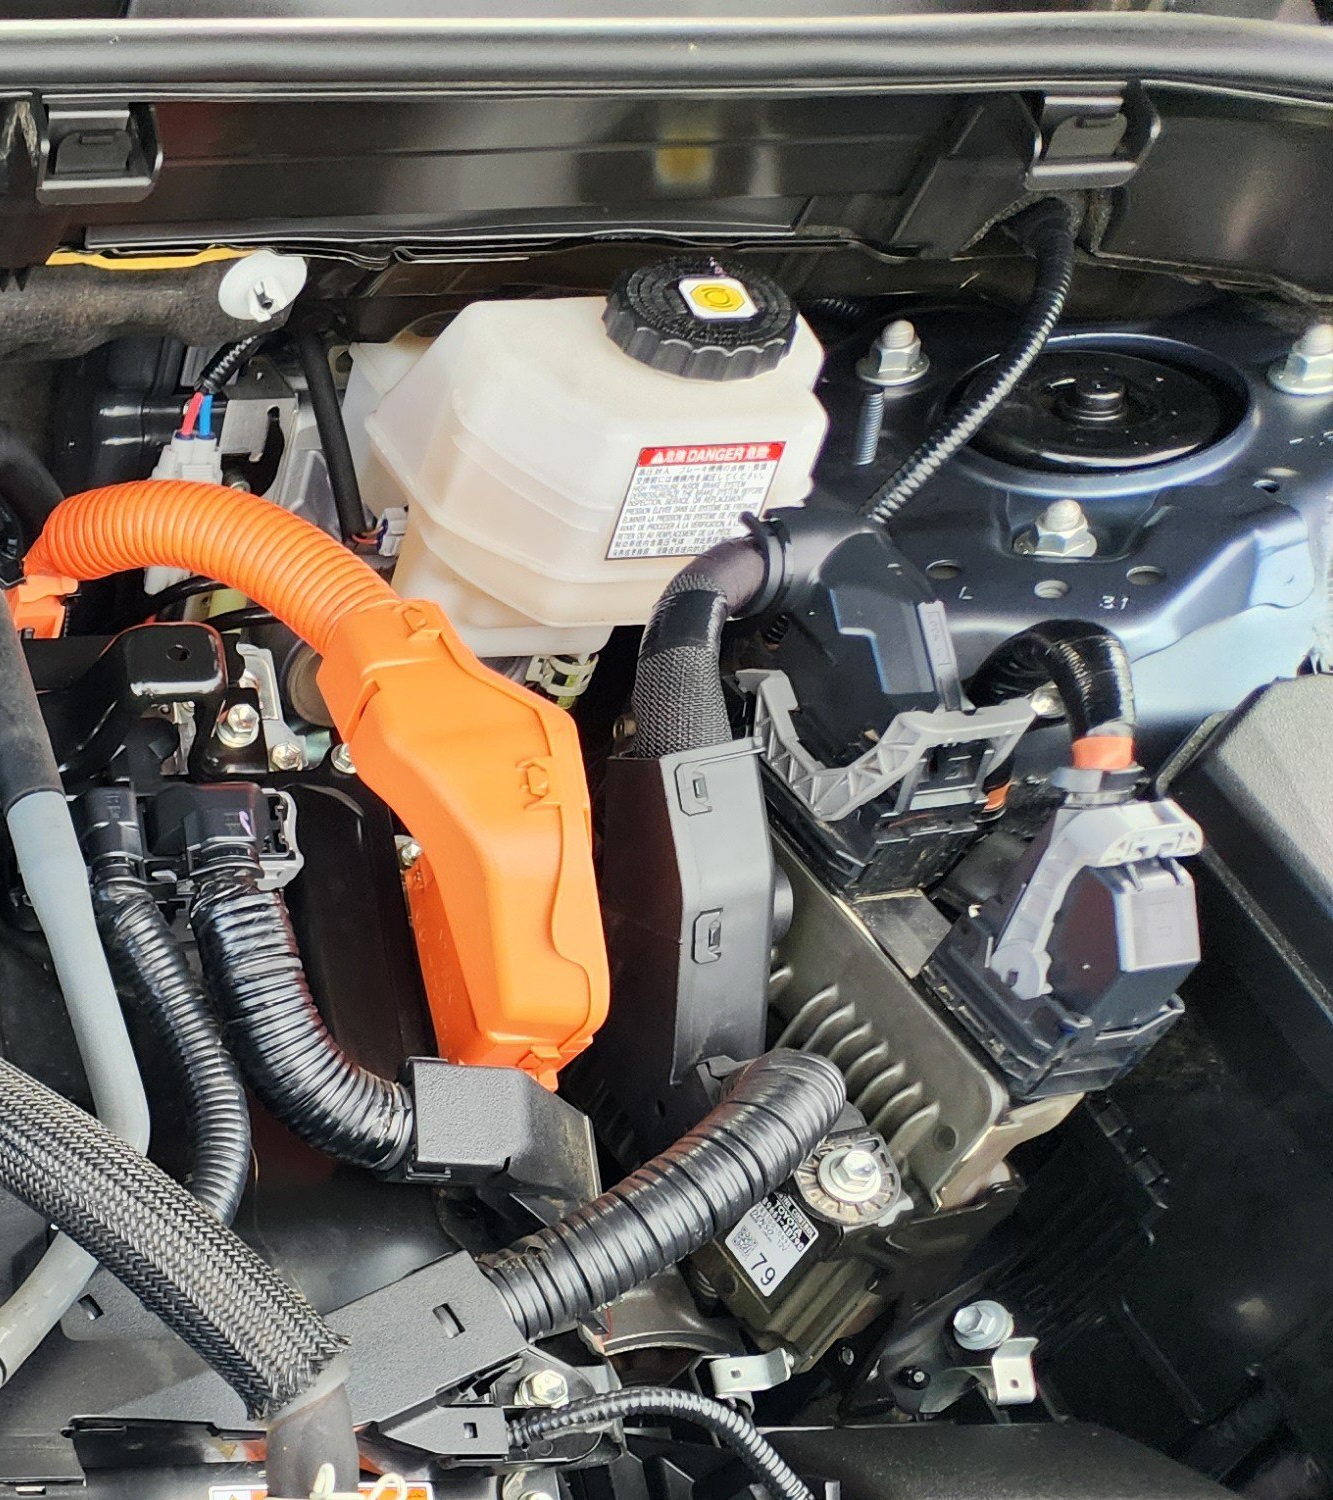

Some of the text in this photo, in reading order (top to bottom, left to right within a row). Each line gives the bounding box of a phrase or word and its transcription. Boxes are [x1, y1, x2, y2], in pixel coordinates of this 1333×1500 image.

[687, 447, 745, 463] DANGER
[750, 1209, 773, 1235] DENSO
[773, 1199, 802, 1238] TOYOTA
[751, 1252, 776, 1286] 79
